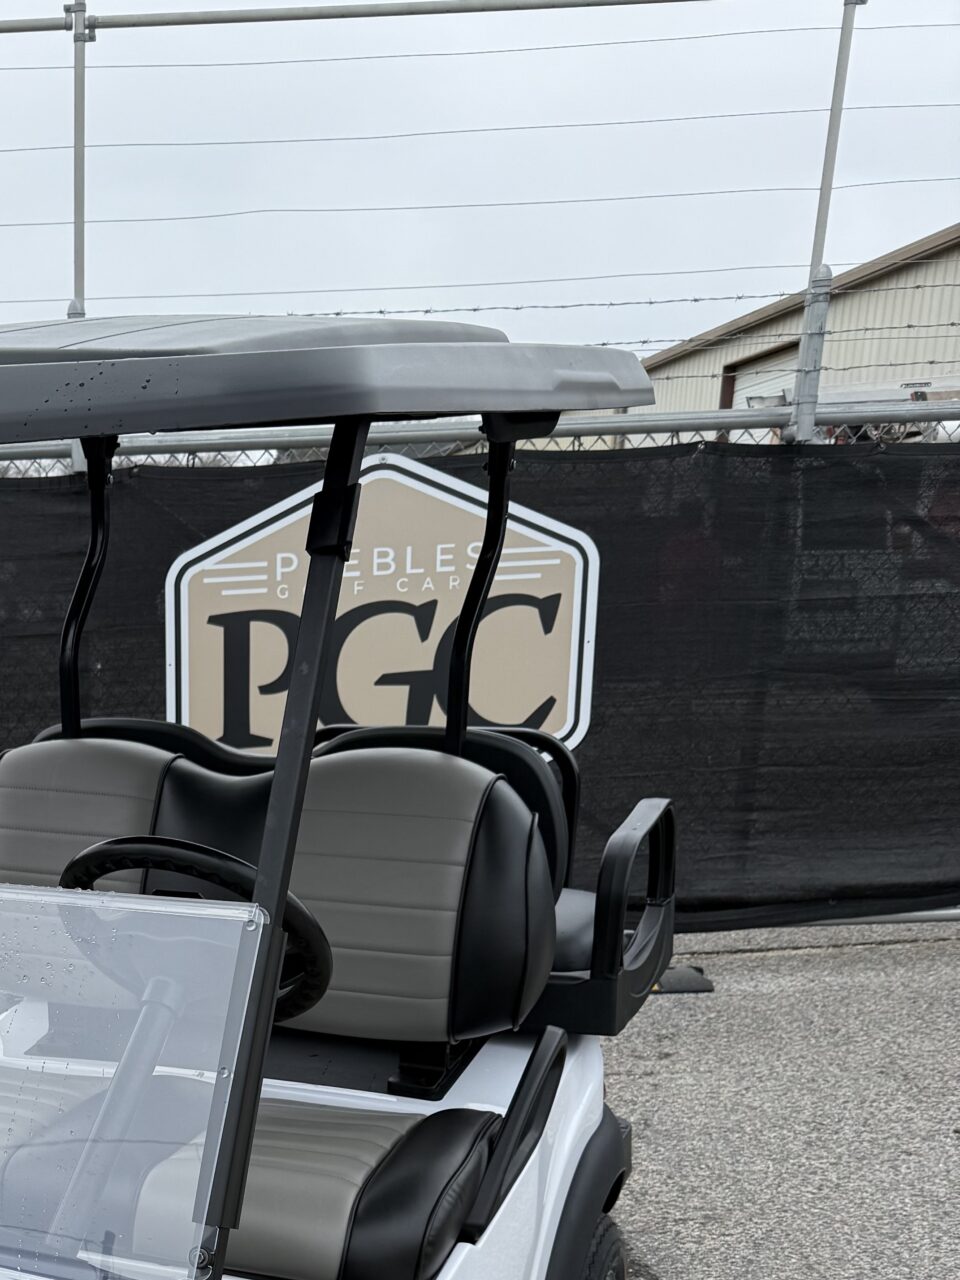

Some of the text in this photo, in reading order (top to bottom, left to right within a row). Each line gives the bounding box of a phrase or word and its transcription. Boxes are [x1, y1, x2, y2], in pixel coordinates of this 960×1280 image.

[276, 542, 484, 581] PEBLES
[277, 580, 365, 599] GF
[207, 592, 562, 749] PGC
